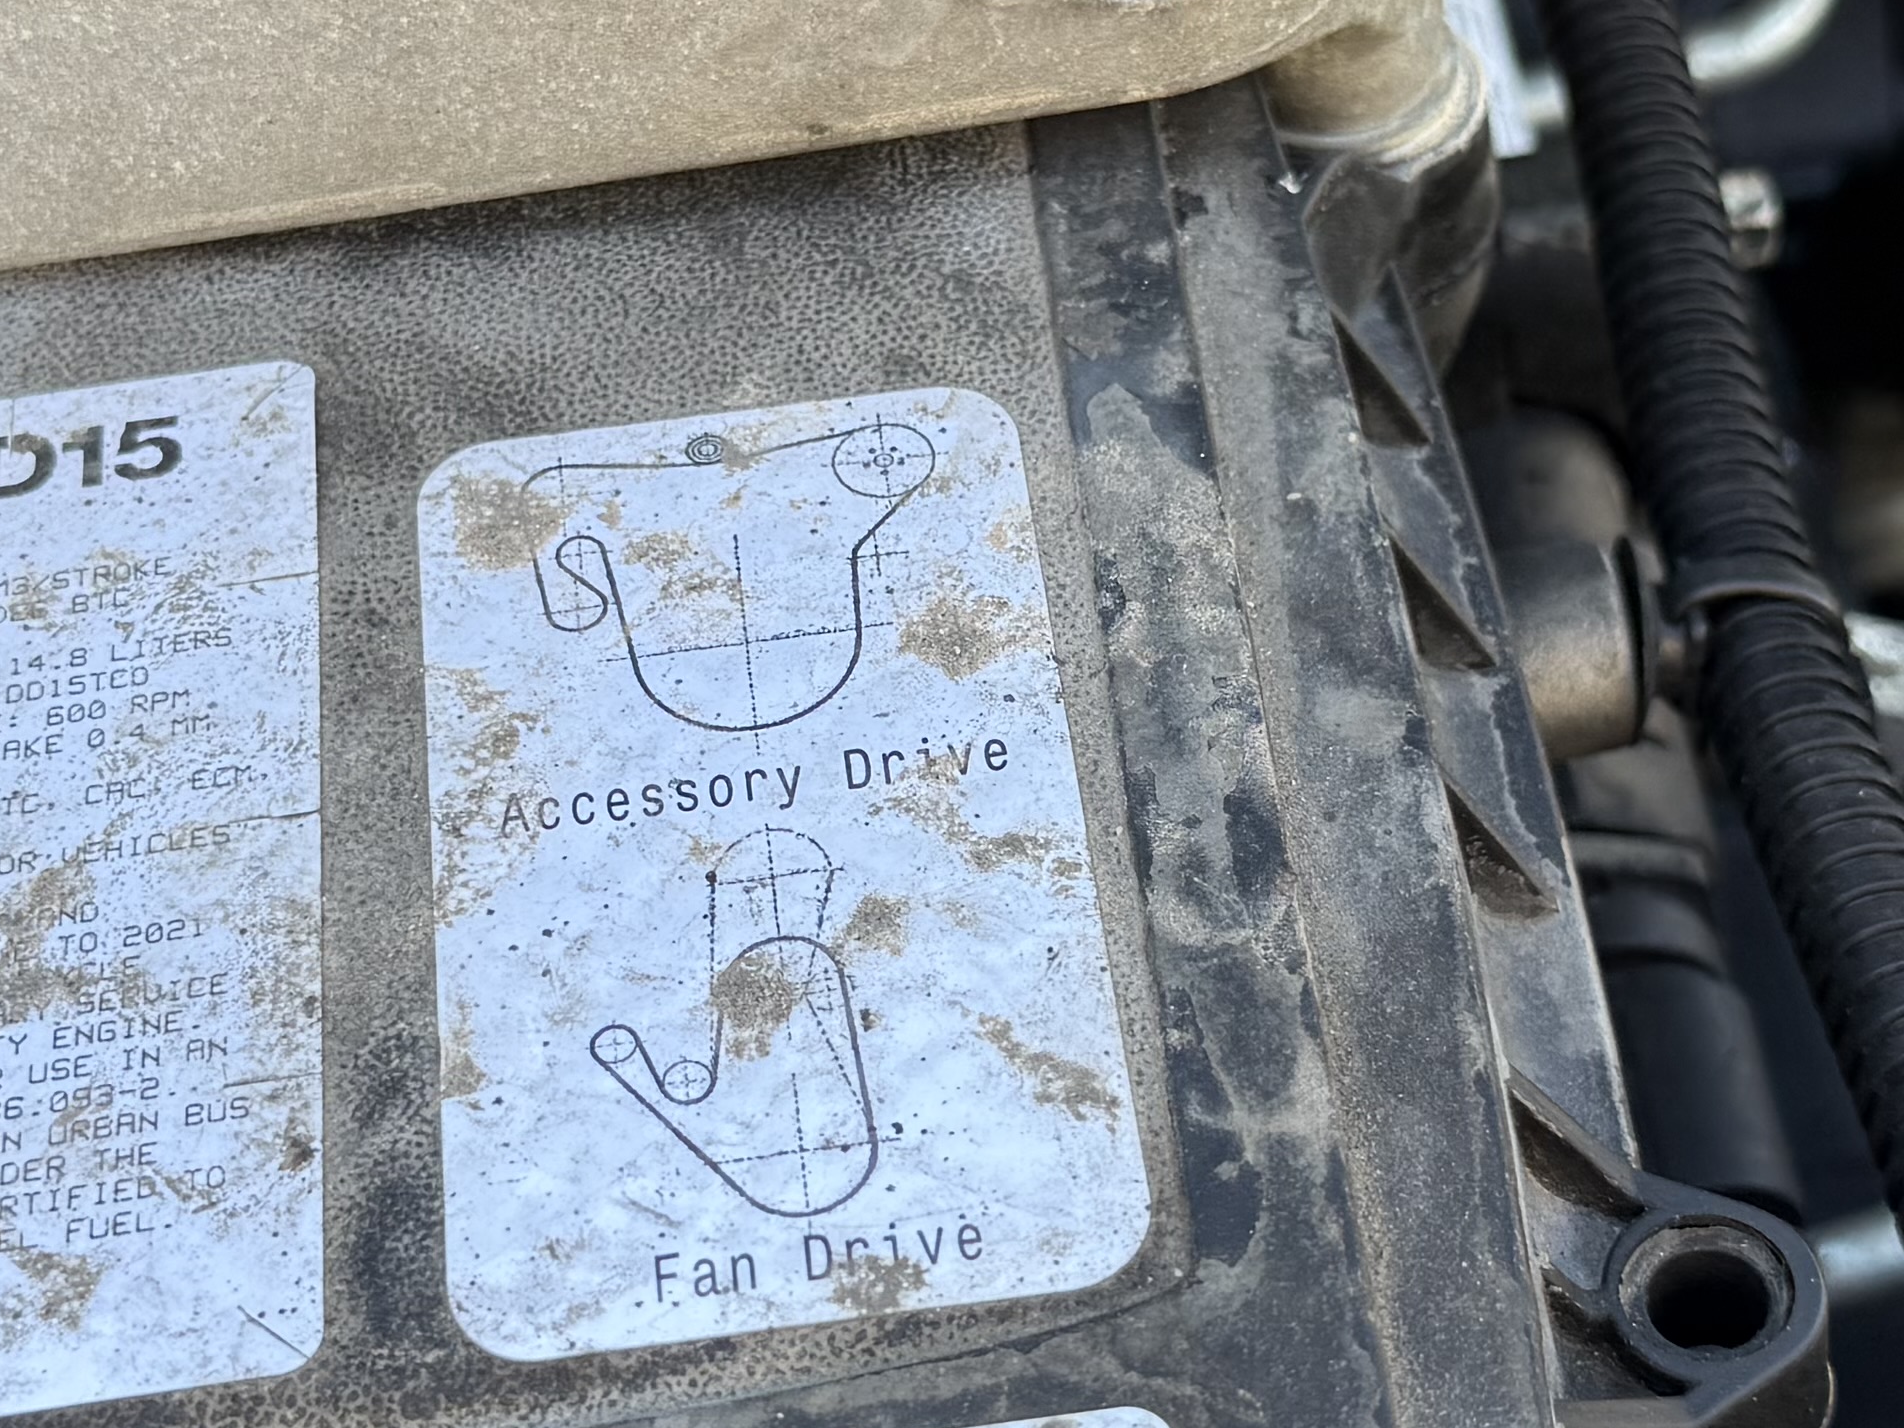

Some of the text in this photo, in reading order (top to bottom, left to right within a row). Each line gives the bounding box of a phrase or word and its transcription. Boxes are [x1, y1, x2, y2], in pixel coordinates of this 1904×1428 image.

[71, 586, 132, 615] BTC
[9, 646, 89, 677] 14.8
[110, 625, 233, 662] LITERS
[45, 697, 108, 728] 600
[129, 685, 192, 716] RPM
[86, 719, 149, 750] 0.4
[170, 710, 212, 737] MM
[499, 725, 1013, 839] Accessory Drive
[55, 929, 98, 958] TO
[121, 913, 205, 949] 2021
[74, 971, 228, 1017] SERVICE
[50, 1005, 200, 1051] ENGINE.
[27, 1052, 94, 1086] USE
[121, 1042, 161, 1072] IN
[184, 1033, 228, 1062] AN
[46, 1106, 159, 1147] URBAN
[182, 1093, 249, 1127] BUS
[90, 1140, 158, 1174] THE
[180, 1162, 225, 1194] TO
[63, 1203, 172, 1245] FUEL.
[652, 1207, 988, 1307] Fan Drive
